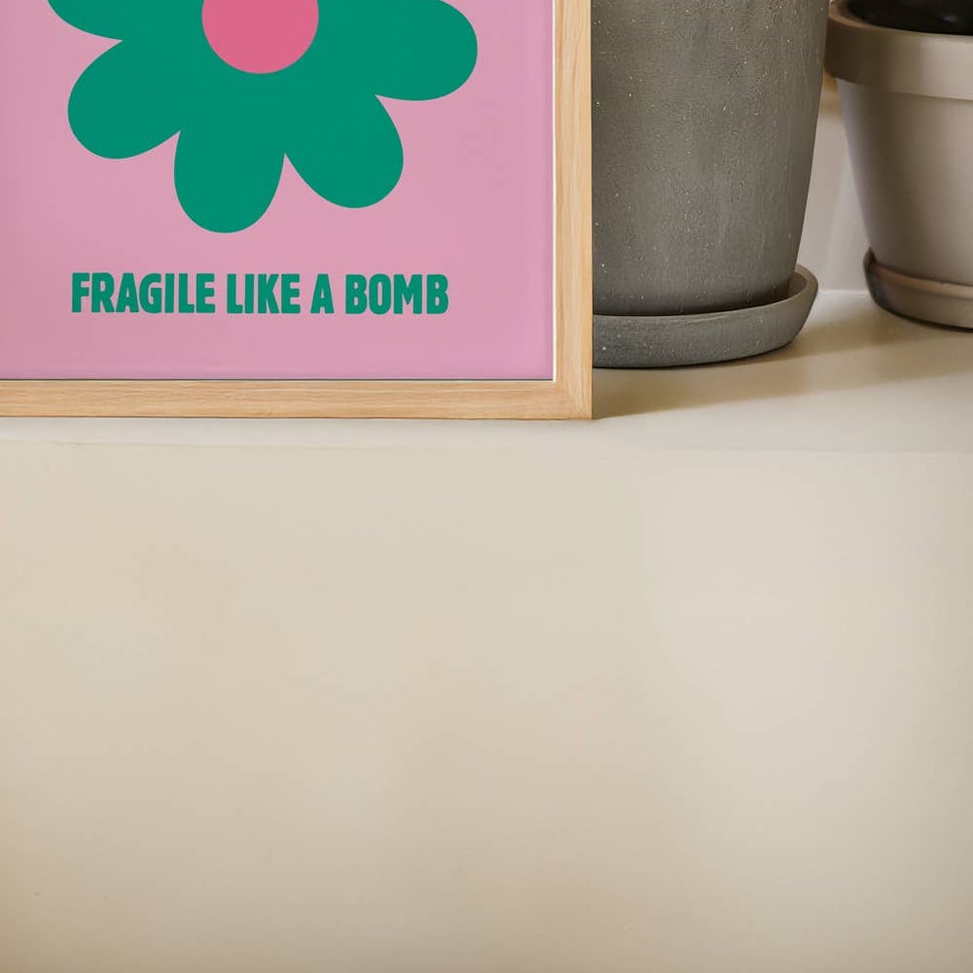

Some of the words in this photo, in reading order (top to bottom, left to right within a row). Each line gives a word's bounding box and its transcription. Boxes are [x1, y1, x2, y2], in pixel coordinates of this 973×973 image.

[72, 272, 215, 313] FRAGILE
[227, 274, 301, 314] LIKE
[310, 274, 334, 314] A
[345, 274, 448, 315] BOMB
